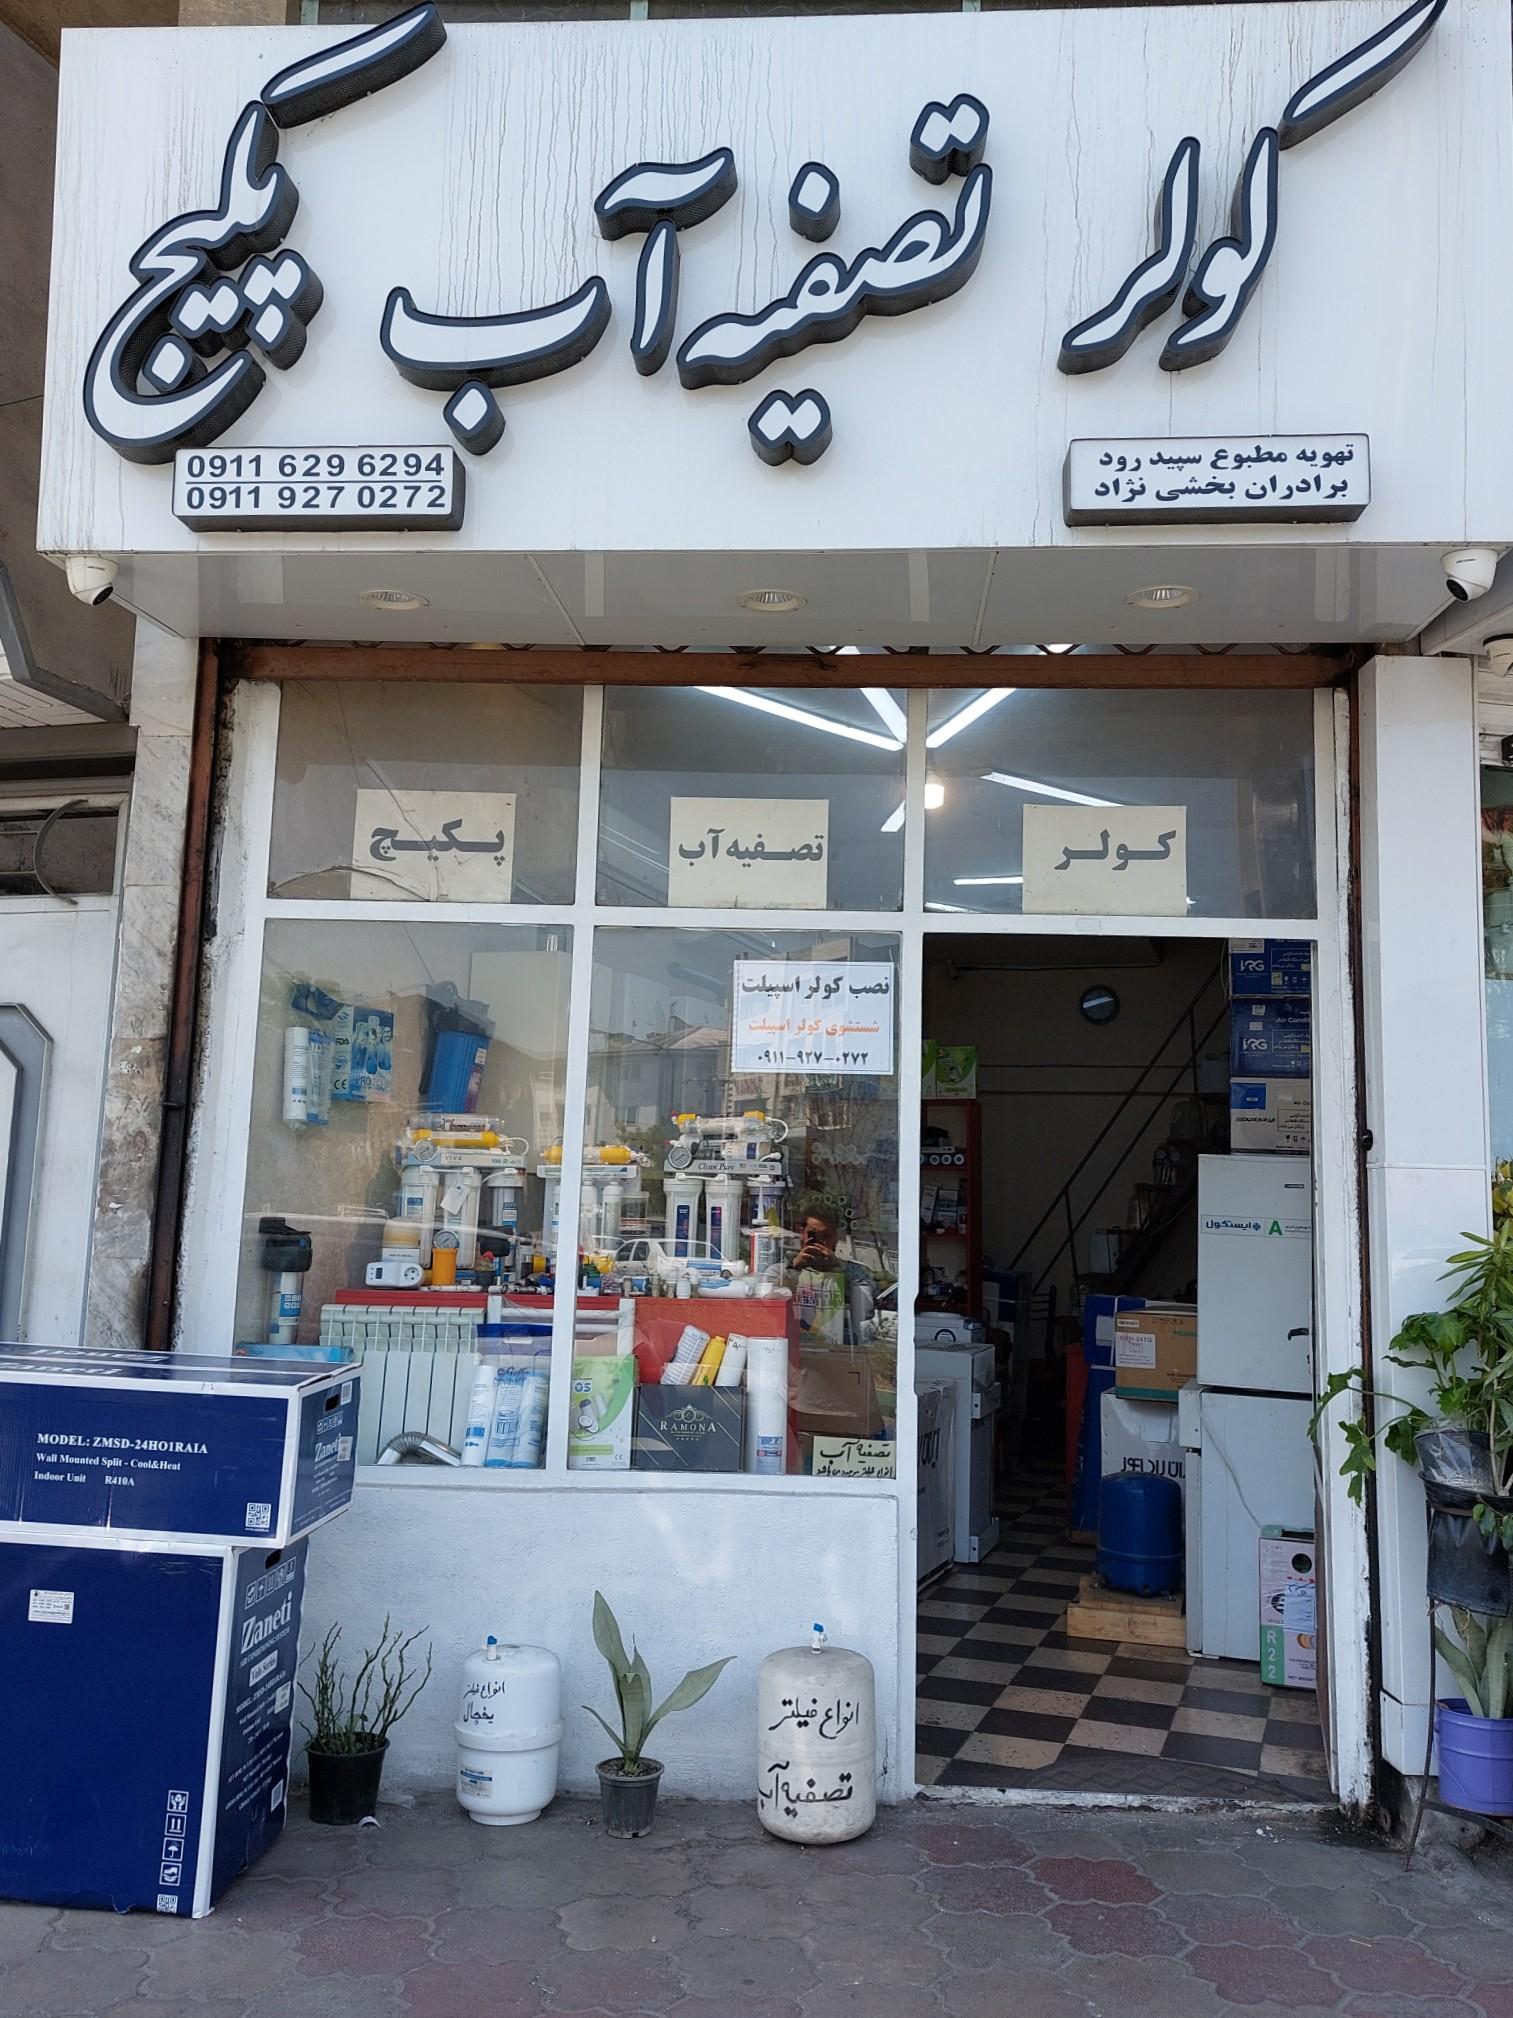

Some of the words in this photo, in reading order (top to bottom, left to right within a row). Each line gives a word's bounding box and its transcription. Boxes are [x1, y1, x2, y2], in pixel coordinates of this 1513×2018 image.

[1057, 0, 1447, 375] کولر
[83, 1, 447, 464] پکیج
[676, 93, 994, 466] تصفیه
[380, 147, 738, 456] آب
[186, 454, 262, 478] 0911
[278, 453, 345, 477] 629
[356, 452, 445, 477] 6294
[1099, 451, 1142, 472] رود
[1149, 451, 1202, 471] سپید
[1210, 444, 1288, 470] مطبوع
[1295, 443, 1354, 467] تهویه
[186, 485, 261, 509] 0911
[277, 485, 345, 509] 927
[356, 484, 446, 508] 0272
[1094, 477, 1147, 503] نژاد
[1155, 476, 1236, 502] بخشی
[1244, 474, 1348, 500] برادران
[369, 818, 506, 867] پکیج
[678, 828, 725, 866] آب
[726, 834, 825, 869] تصفیه
[1054, 829, 1177, 871] کولر
[741, 974, 800, 1000] اسپیلت
[803, 975, 844, 1000] کولر
[849, 976, 890, 999] نصب
[794, 1018, 822, 1036] کولر
[1269, 1220, 1283, 1236] A
[660, 1420, 717, 1432] RAMONA
[37, 1433, 90, 1447] MODEL:
[820, 1439, 860, 1465] آب
[856, 1443, 891, 1463] تصفیه
[36, 1453, 58, 1463] Wall
[59, 1454, 100, 1466] Mounted
[101, 1457, 122, 1468] Split
[34, 1471, 65, 1482] Indoor
[67, 1474, 86, 1483] Unit
[105, 1475, 135, 1487] R410A
[241, 1591, 292, 1655] Zaneti
[481, 1681, 505, 1699] انواع
[768, 1697, 818, 1731] فیلتر
[818, 1699, 859, 1740] انواع
[780, 1772, 853, 1818] تصفیه
